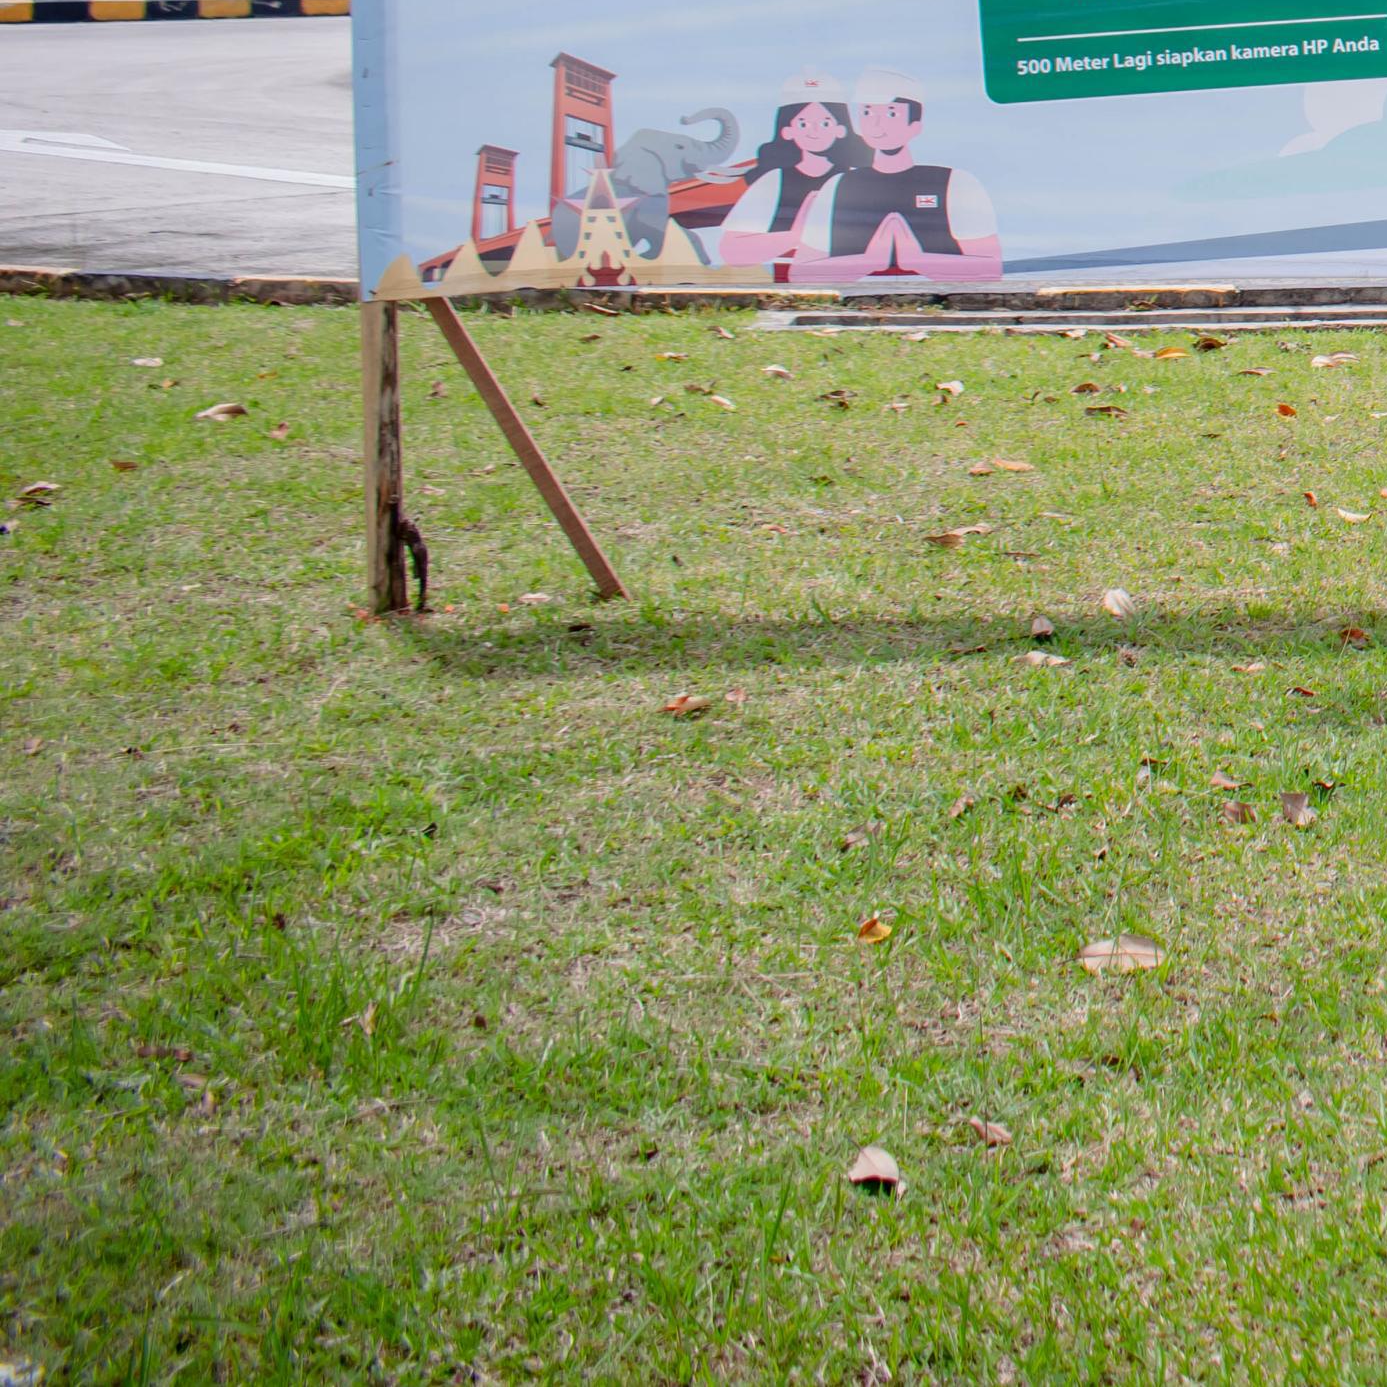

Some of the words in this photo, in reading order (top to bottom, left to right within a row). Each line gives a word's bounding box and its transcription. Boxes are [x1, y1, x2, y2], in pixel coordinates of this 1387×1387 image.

[1017, 58, 1051, 75] 500
[1055, 54, 1110, 73] Meter
[1113, 50, 1152, 71] Lagi
[1156, 46, 1227, 67] siapkan
[1231, 43, 1299, 61] kamera
[1303, 39, 1328, 55] HP
[1332, 35, 1380, 53] Anda
